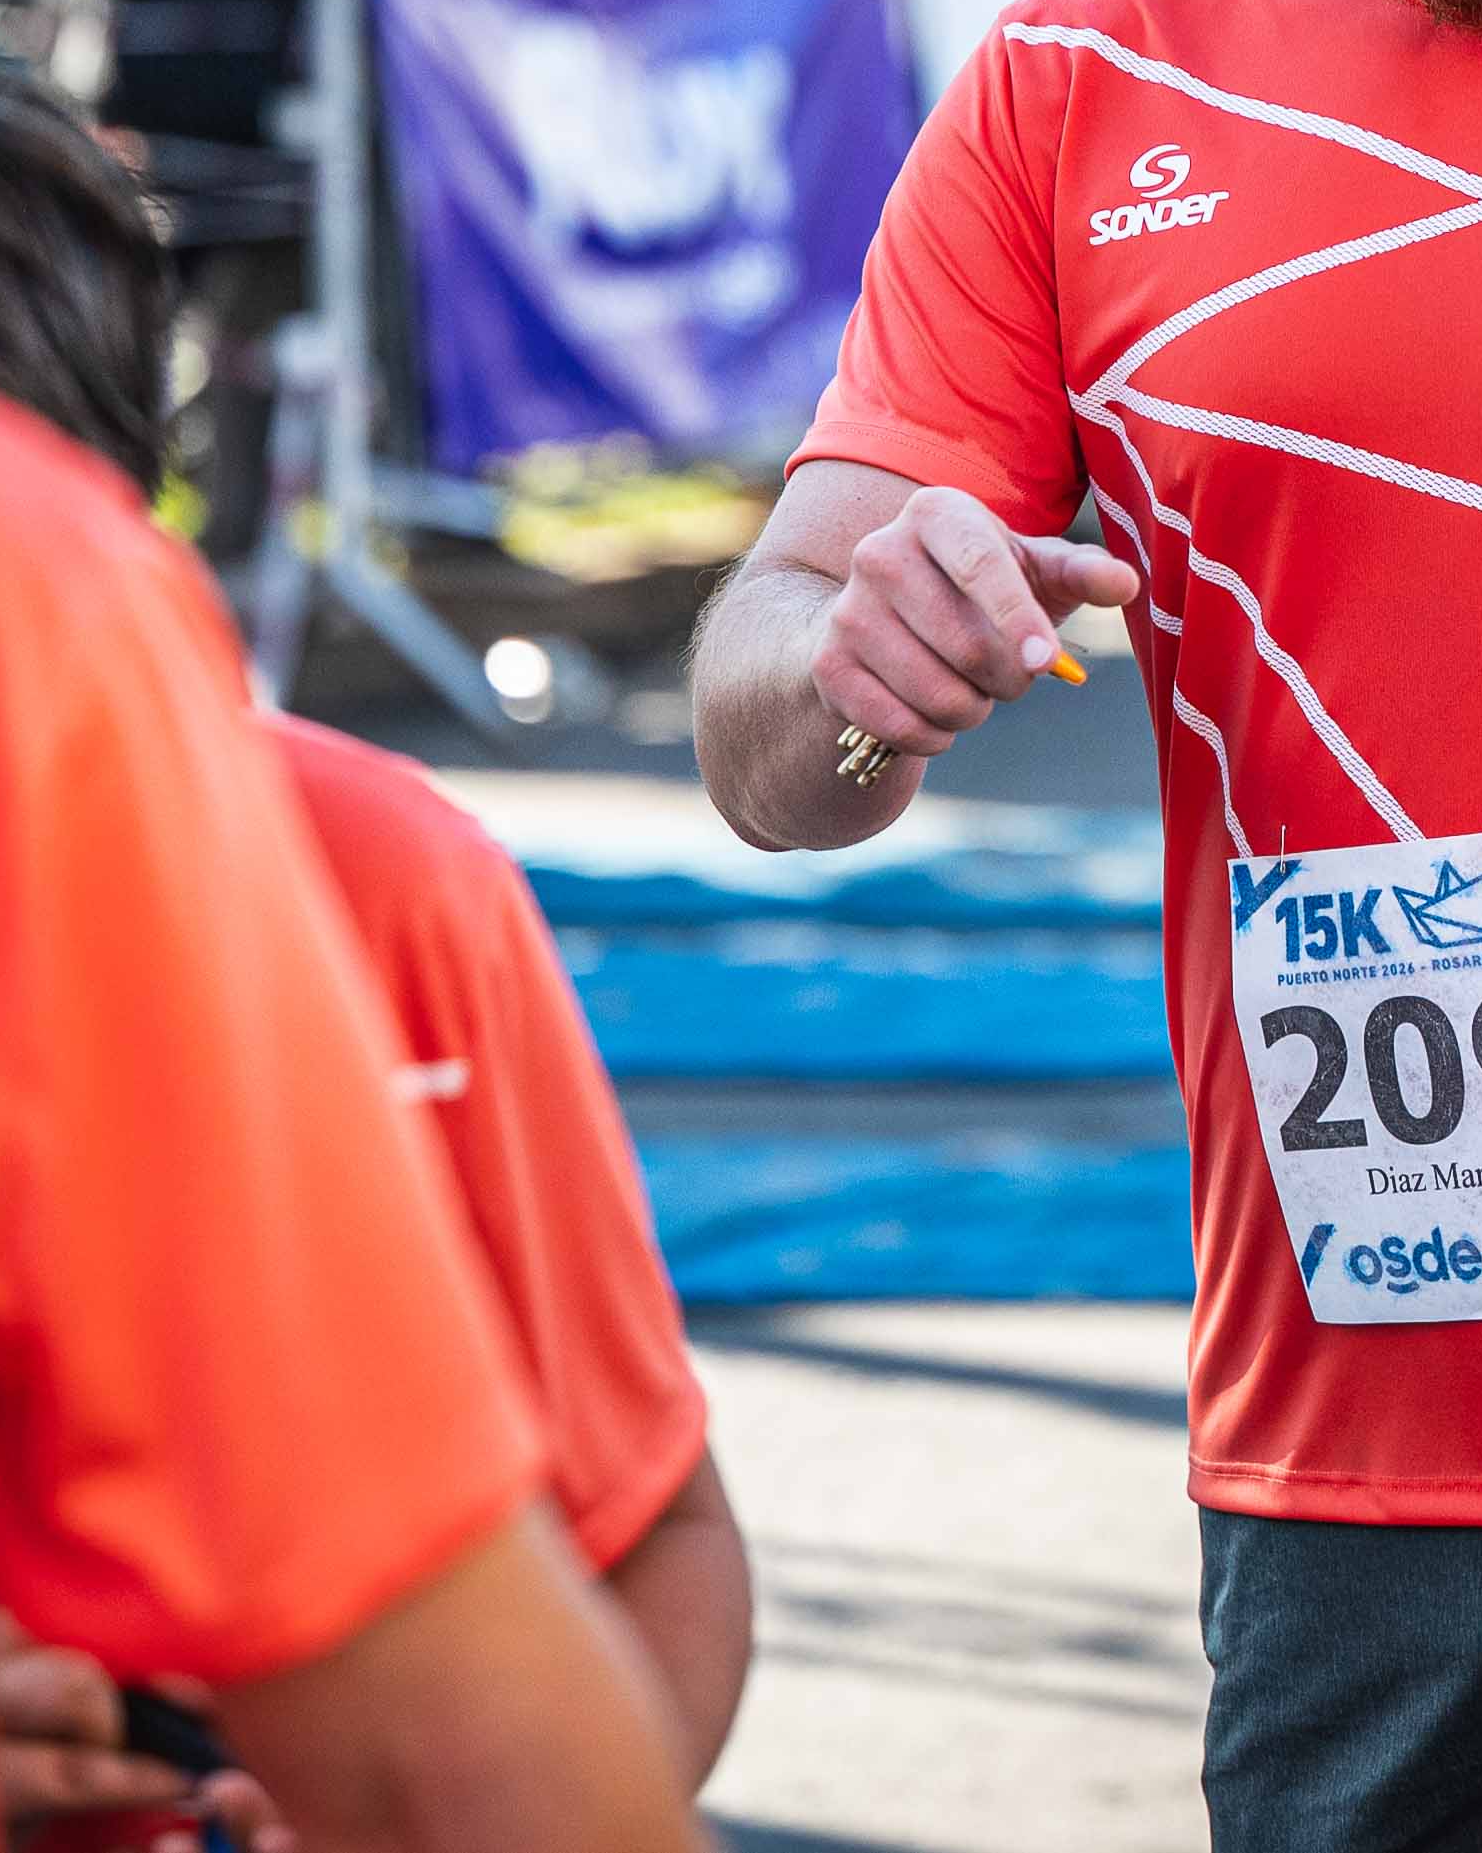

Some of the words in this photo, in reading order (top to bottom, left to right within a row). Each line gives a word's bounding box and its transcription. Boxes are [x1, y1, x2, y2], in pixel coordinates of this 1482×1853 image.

[1275, 888, 1392, 962] 15K
[1277, 970, 1329, 986] PUERTO
[1333, 967, 1377, 982] NORTE
[1382, 962, 1416, 978] 2026
[1366, 1166, 1427, 1196] Diaz
